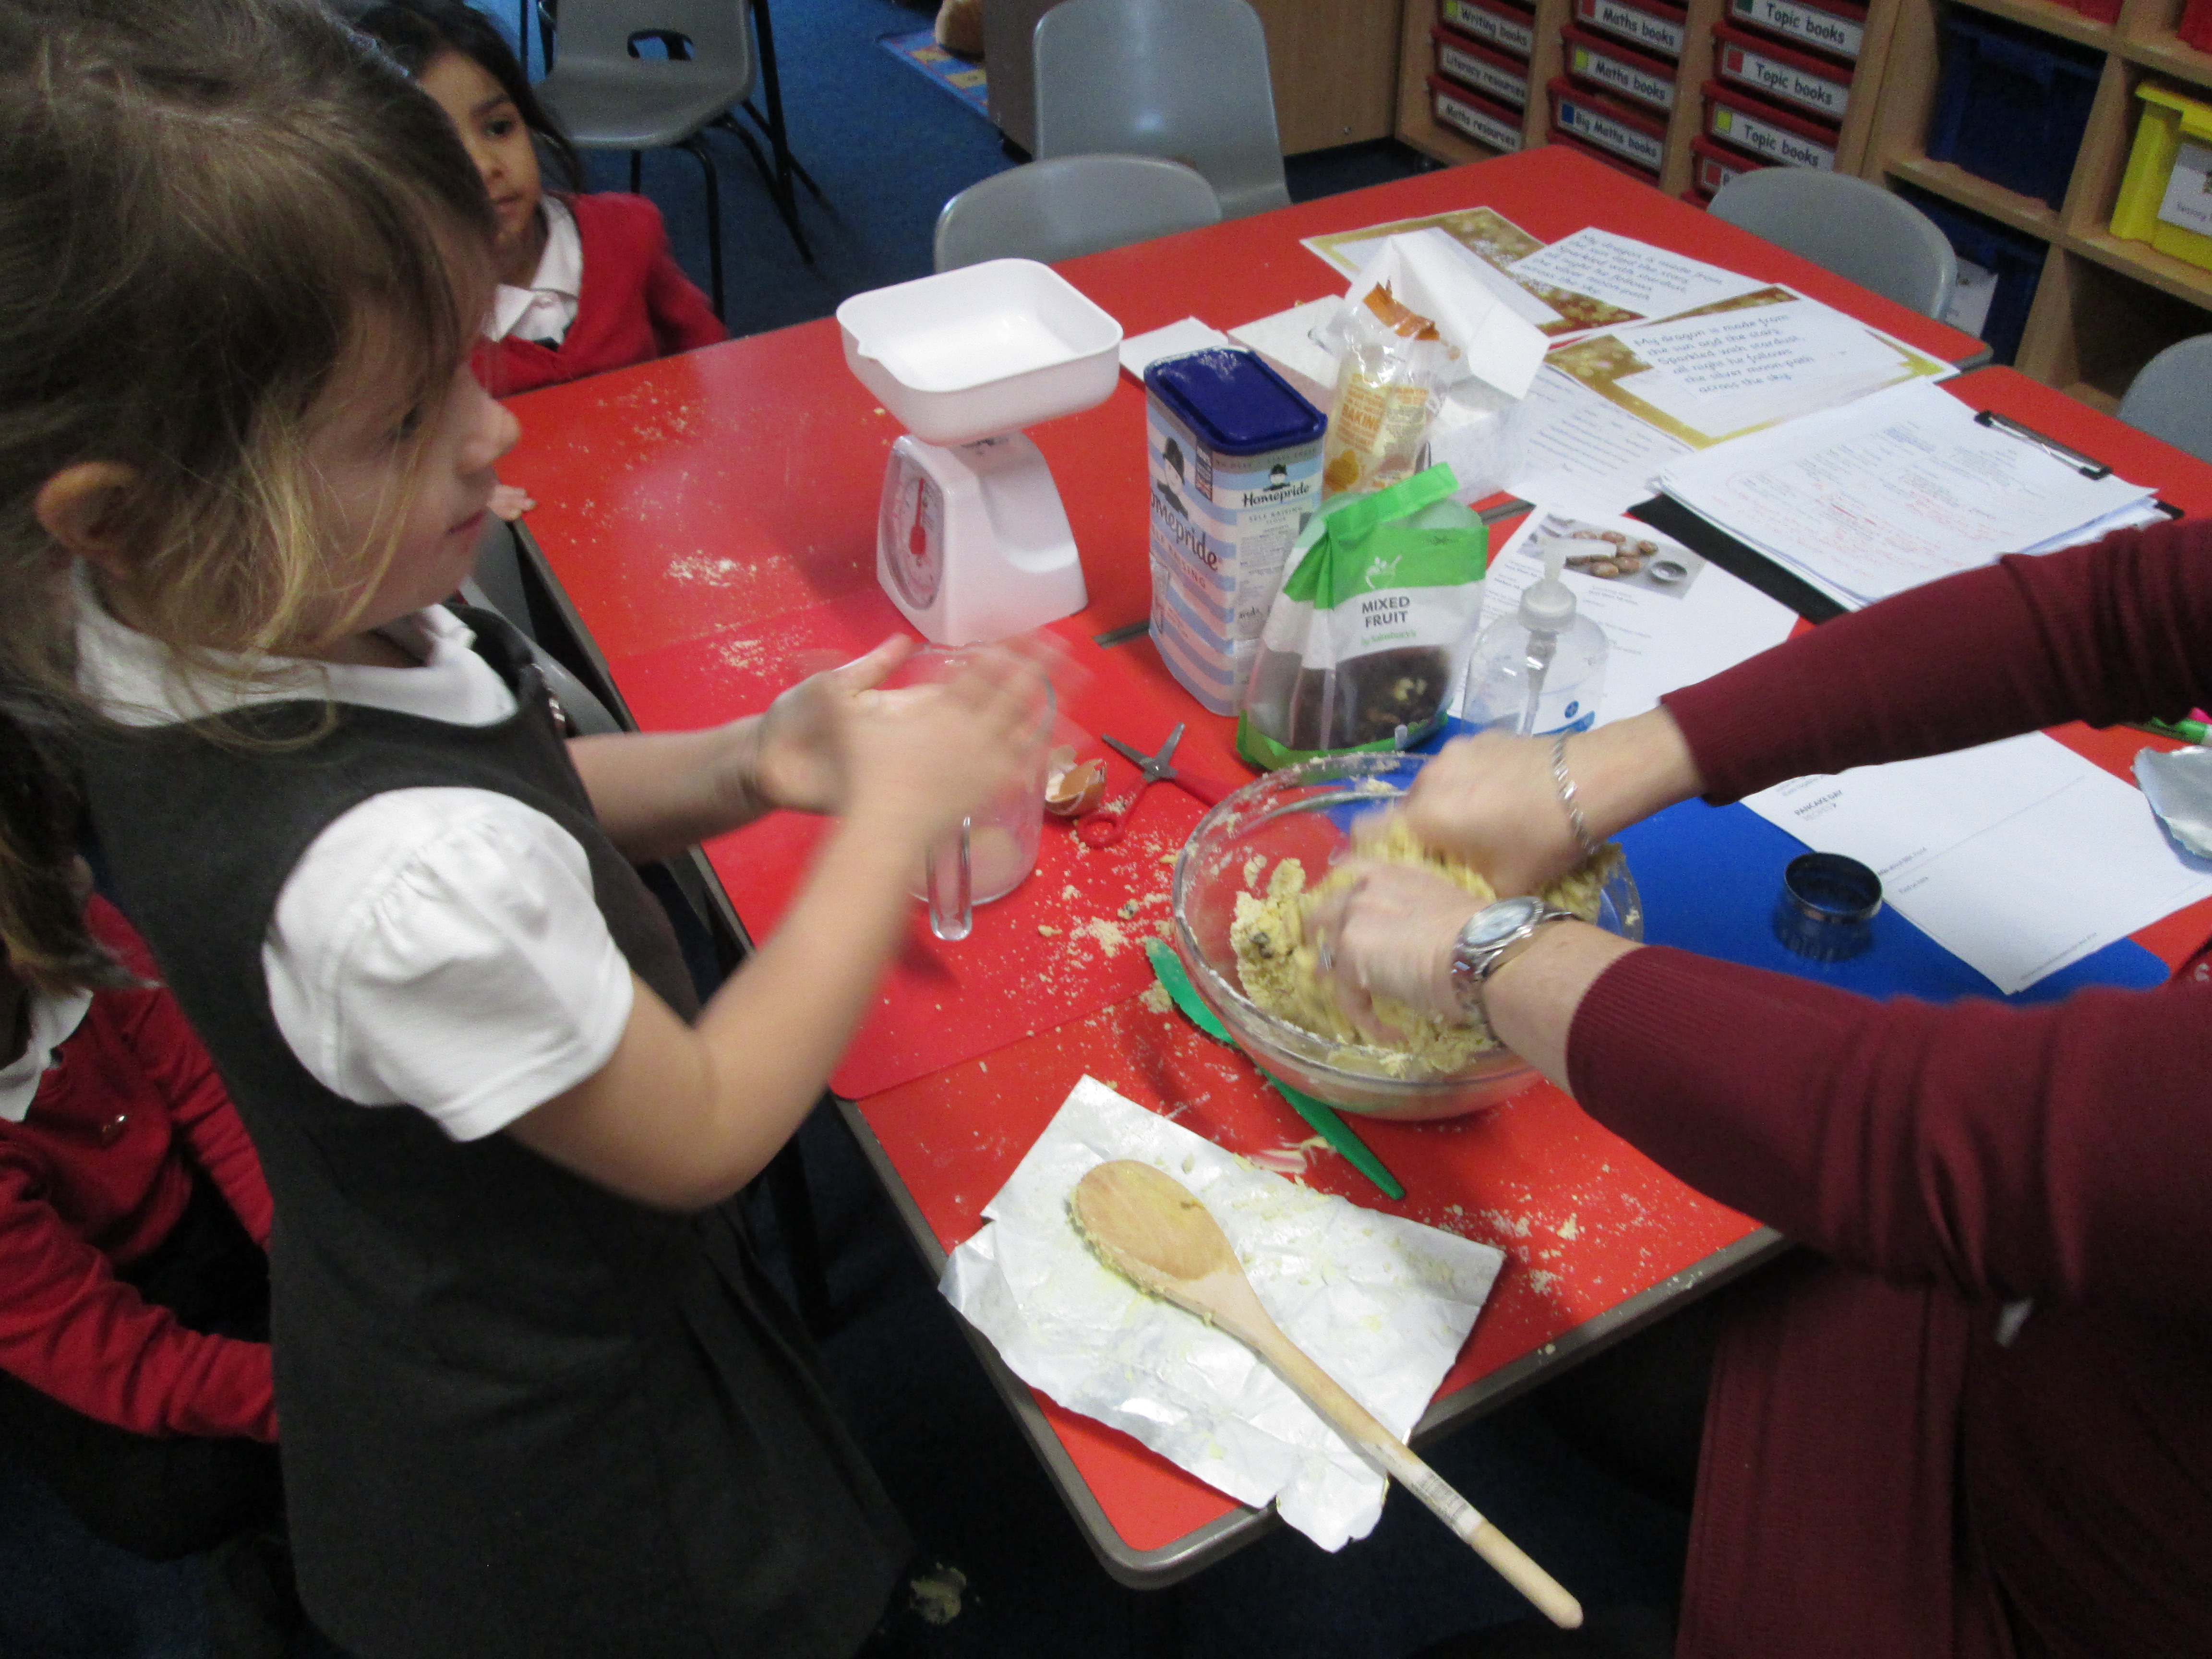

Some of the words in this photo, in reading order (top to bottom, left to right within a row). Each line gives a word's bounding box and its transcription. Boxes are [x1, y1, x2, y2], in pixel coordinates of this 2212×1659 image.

[1603, 7, 1637, 31] Maths
[1642, 22, 1675, 46] books
[1767, 2, 1800, 27] Topic
[1806, 16, 1845, 44] books
[1596, 60, 1628, 85] Maths
[1634, 75, 1665, 100] books
[1755, 62, 1788, 87] Topic
[1795, 77, 1832, 105] books
[1594, 120, 1623, 143] Maths
[1629, 136, 1657, 157] books
[1744, 124, 1776, 149] Topic
[1782, 138, 1818, 166] books
[1242, 481, 1311, 508] Homepride
[1249, 514, 1267, 523] SELF
[1271, 506, 1303, 518] RAISING
[1168, 543, 1206, 589] RAISING
[1361, 596, 1410, 614] MIXED
[1365, 610, 1408, 628] FRUIT
